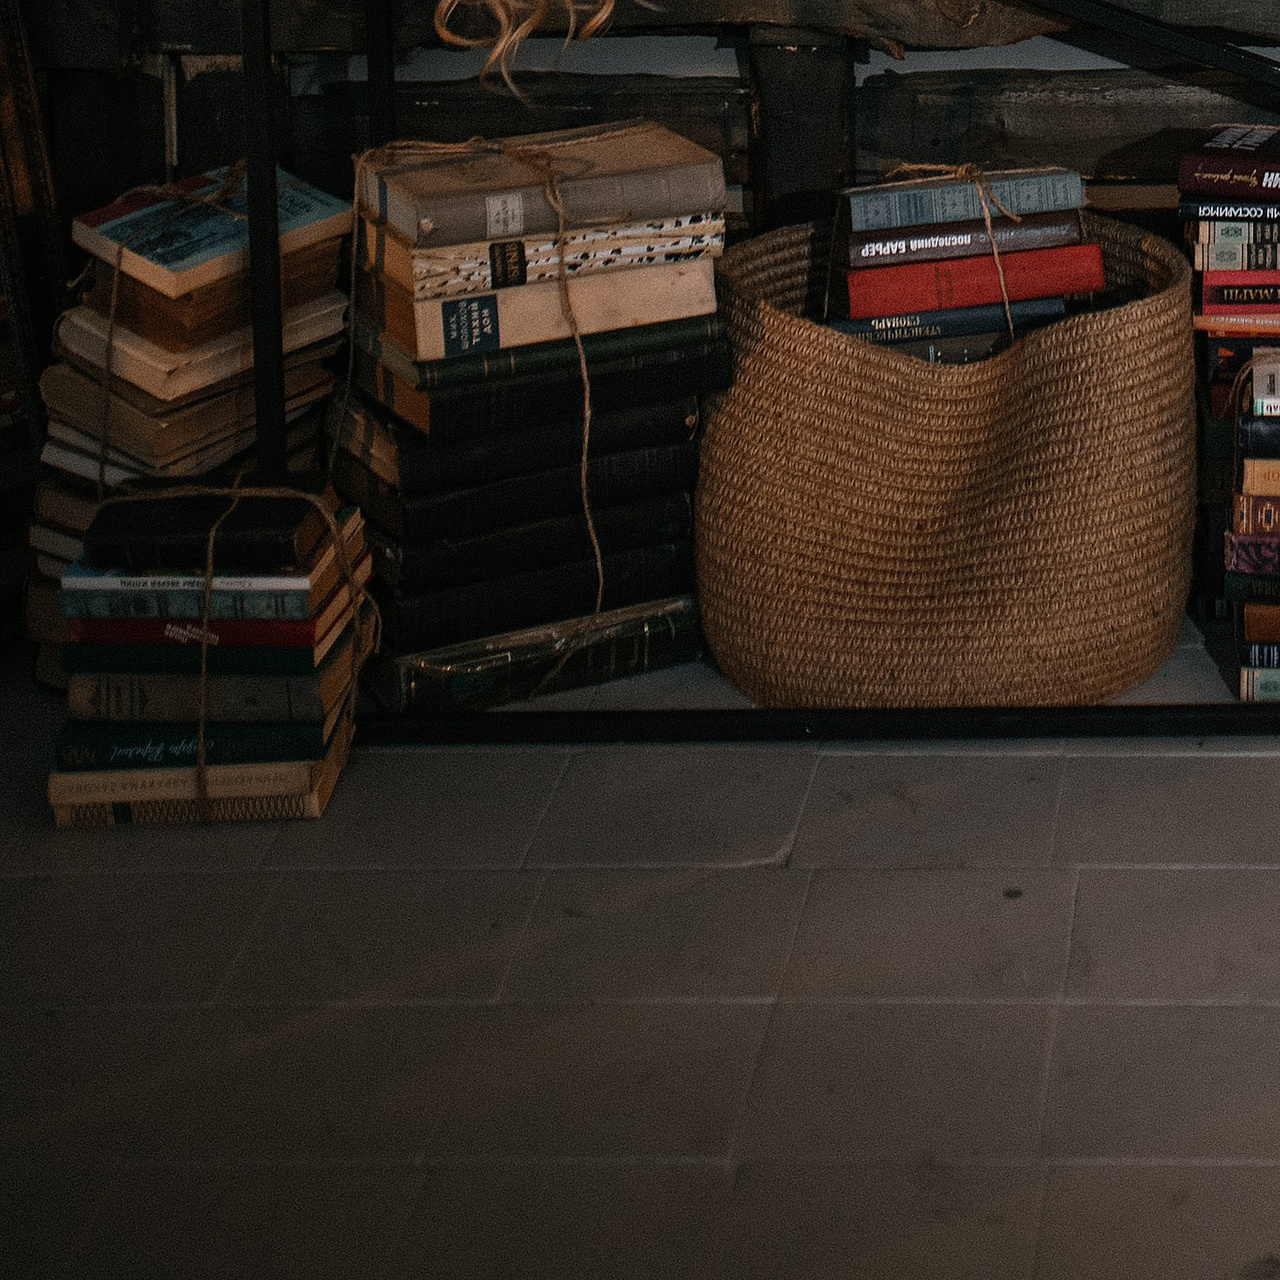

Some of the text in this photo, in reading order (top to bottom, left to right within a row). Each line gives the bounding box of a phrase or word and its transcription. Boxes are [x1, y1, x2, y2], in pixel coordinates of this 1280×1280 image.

[1198, 206, 1263, 219] СОСТАРИМСЯ
[861, 240, 906, 256] БАРЬЕР
[1223, 288, 1274, 301] МАРШ
[469, 301, 481, 346] ТИХИЙ
